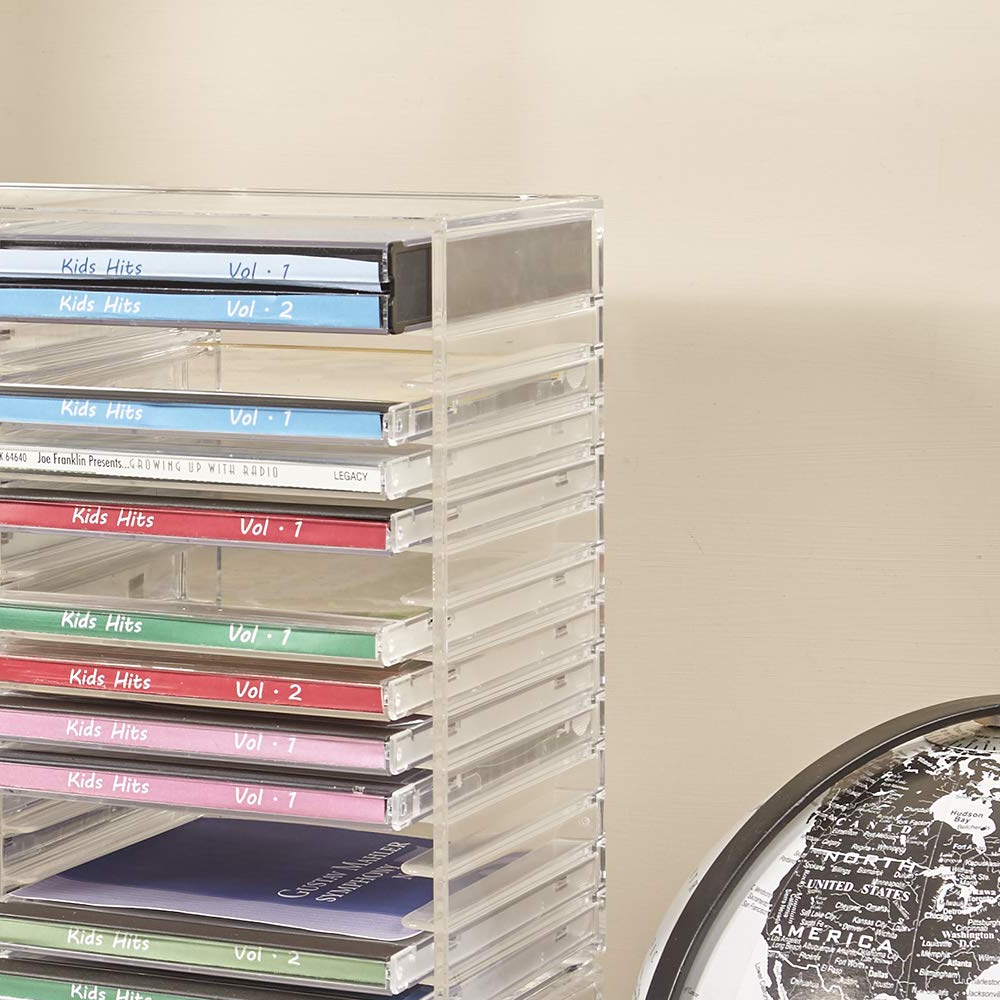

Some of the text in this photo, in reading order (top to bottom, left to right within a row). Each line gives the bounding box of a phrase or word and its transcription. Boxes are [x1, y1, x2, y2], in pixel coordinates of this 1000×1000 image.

[61, 257, 289, 280] Kids Hits Vol 1
[59, 295, 293, 318] Kids Hits Vol 2
[61, 400, 291, 427] Kids Hits Vol 1
[5, 452, 28, 464] 64640
[37, 453, 51, 465] Joe
[54, 453, 86, 467] Franklin
[187, 461, 203, 475] UP
[207, 462, 234, 476] WITH
[243, 465, 279, 479] RADIO
[333, 470, 368, 483] LEGACY
[72, 506, 303, 538] Kids Hits Vol 1
[61, 610, 291, 646] Kids Hits Vol 1
[69, 668, 302, 701] Kids Hits Vol 2
[66, 718, 296, 754] Kids Hits Vol 1
[950, 809, 984, 819] Hudson
[954, 815, 971, 825] Bay
[331, 841, 411, 871] MAHLER
[824, 851, 917, 872] NORTH
[315, 863, 401, 903] SYMPHONY
[807, 878, 911, 902] UNITED STATES
[770, 924, 893, 953] AMERICA
[941, 930, 995, 940] Washington
